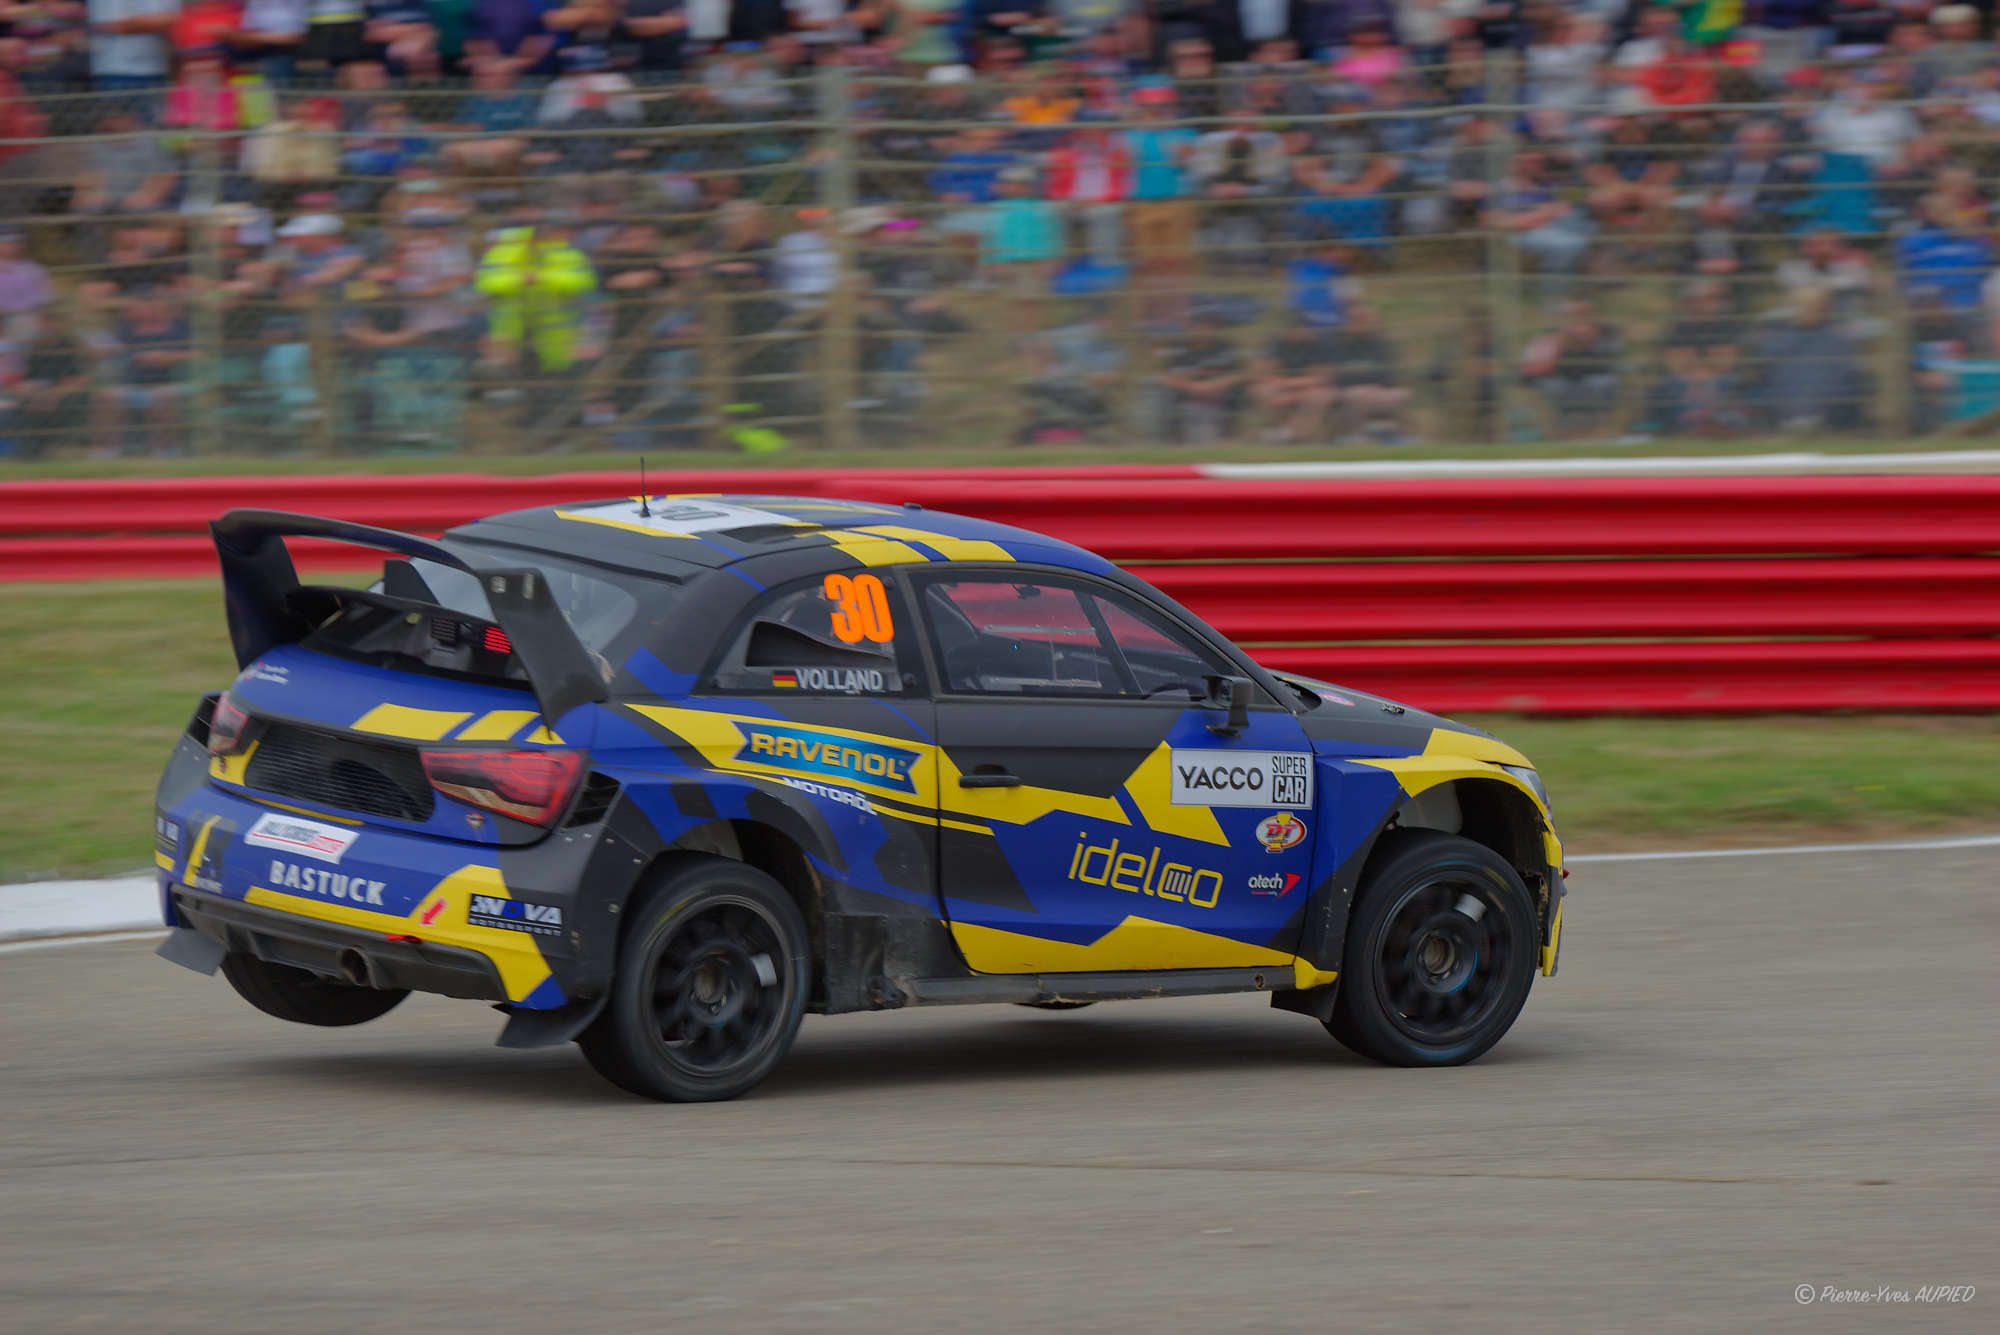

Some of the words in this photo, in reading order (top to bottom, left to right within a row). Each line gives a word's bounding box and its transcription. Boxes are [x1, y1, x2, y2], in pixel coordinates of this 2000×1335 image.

[823, 573, 895, 644] 30
[795, 668, 885, 691] VOLLAND
[751, 732, 905, 781] RAVENOL
[1272, 755, 1306, 775] SUPER
[1177, 765, 1264, 791] YACCO
[1272, 776, 1305, 803] CAR
[269, 860, 386, 906] BASTUCK
[1068, 831, 1224, 909] idelco
[1248, 872, 1283, 889] atech
